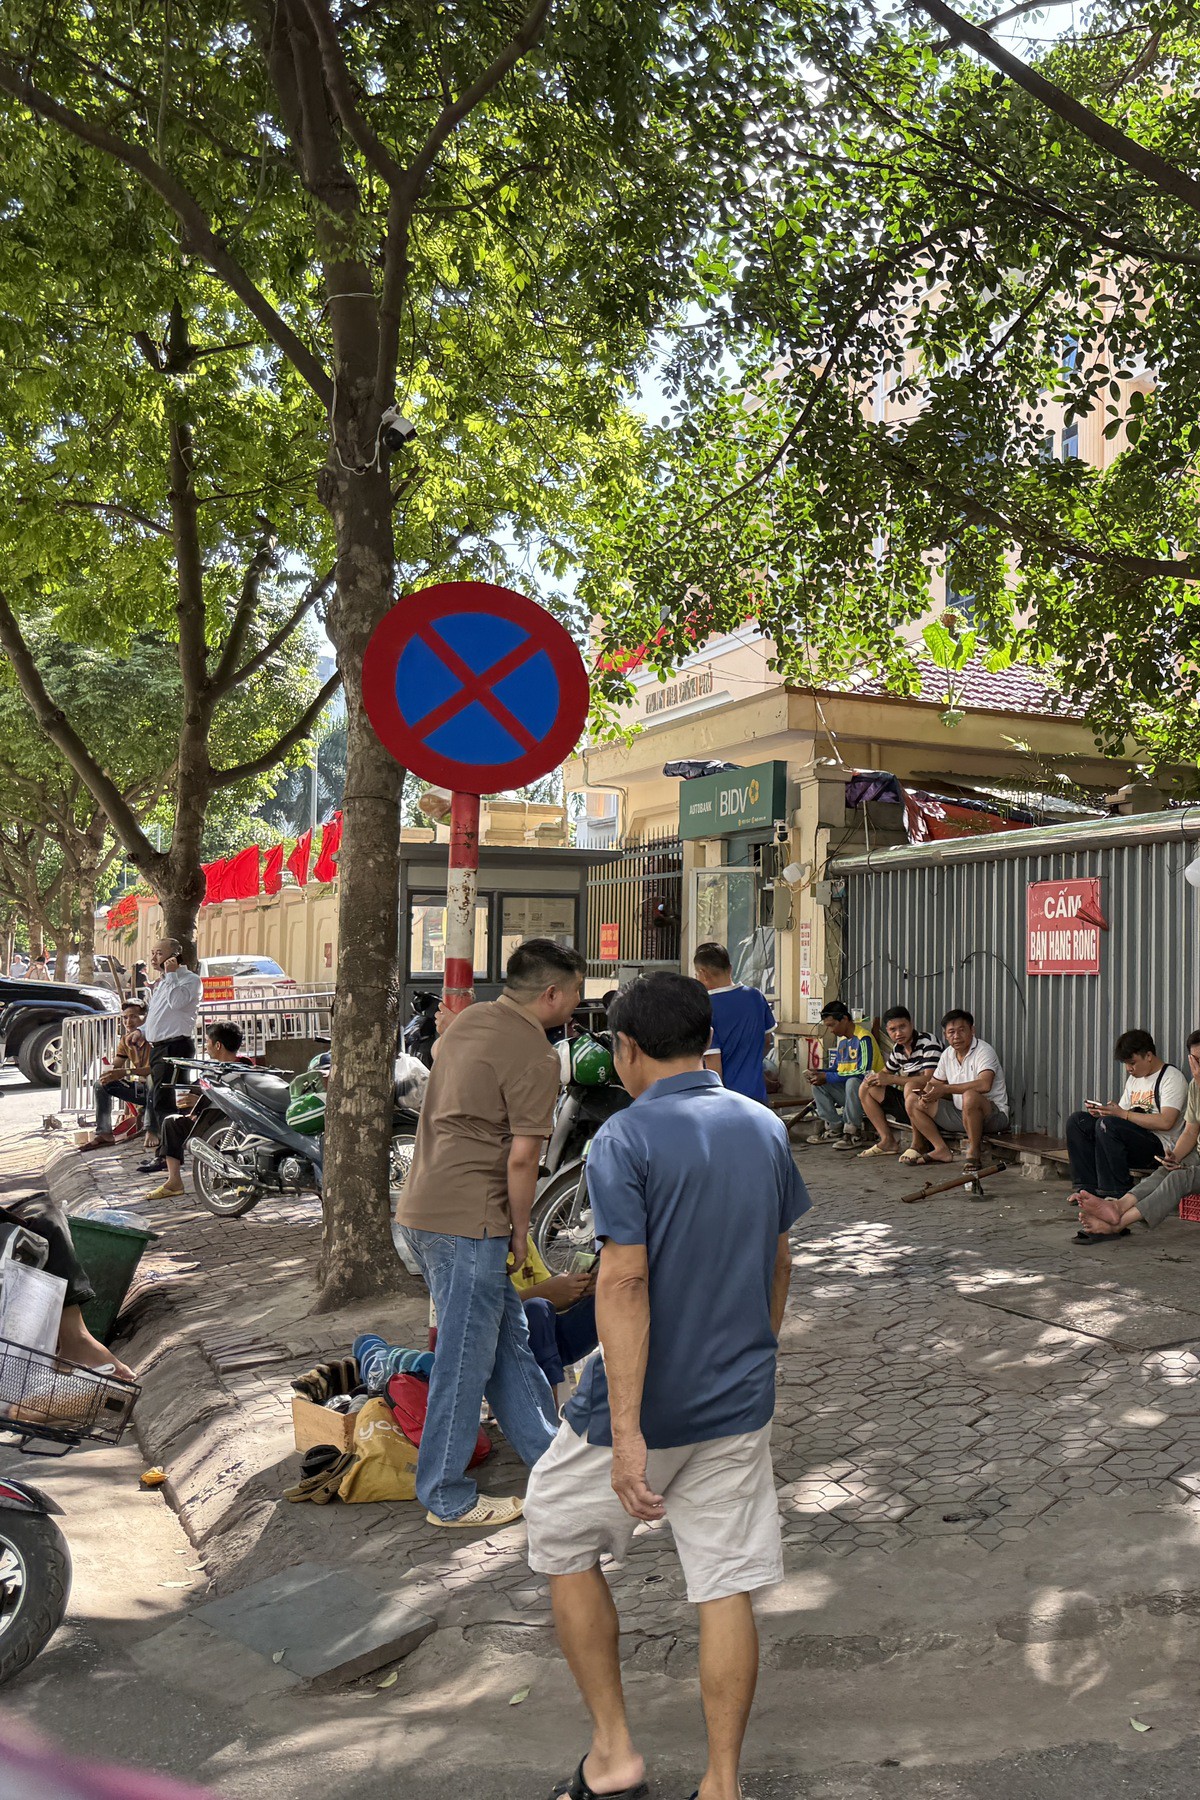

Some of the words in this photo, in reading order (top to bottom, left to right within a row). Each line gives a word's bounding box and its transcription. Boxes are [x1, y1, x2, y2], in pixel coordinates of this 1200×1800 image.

[720, 786, 749, 816] BIDV
[1044, 886, 1082, 919] CẤM
[1073, 928, 1096, 961] RONG
